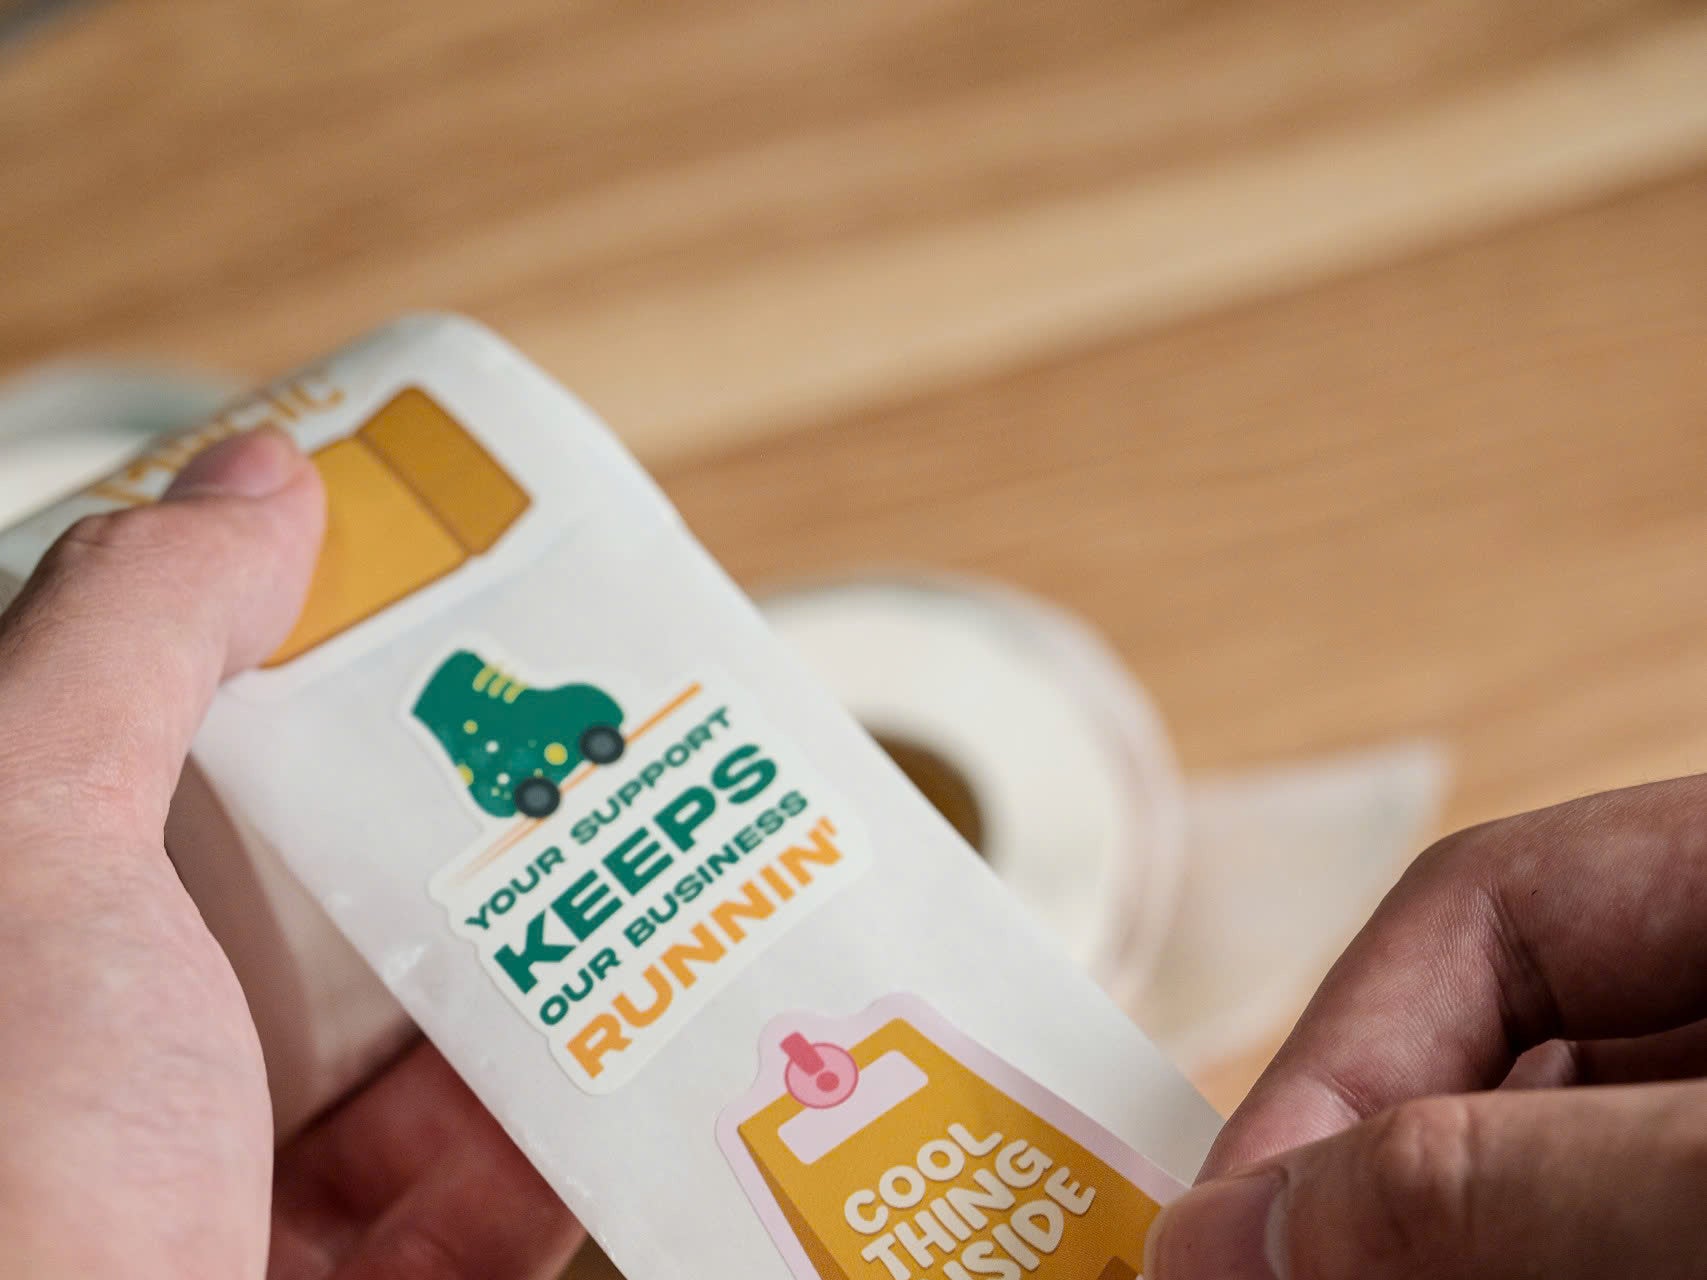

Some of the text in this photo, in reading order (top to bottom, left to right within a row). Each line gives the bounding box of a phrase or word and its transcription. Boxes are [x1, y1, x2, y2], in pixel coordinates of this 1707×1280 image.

[465, 706, 732, 930] YOUR SUPPORT
[493, 744, 777, 995] KEEPS
[539, 791, 808, 1026] OUR BUSINESS
[566, 816, 843, 1079] RUNNIN'
[843, 1123, 1003, 1235] COOL
